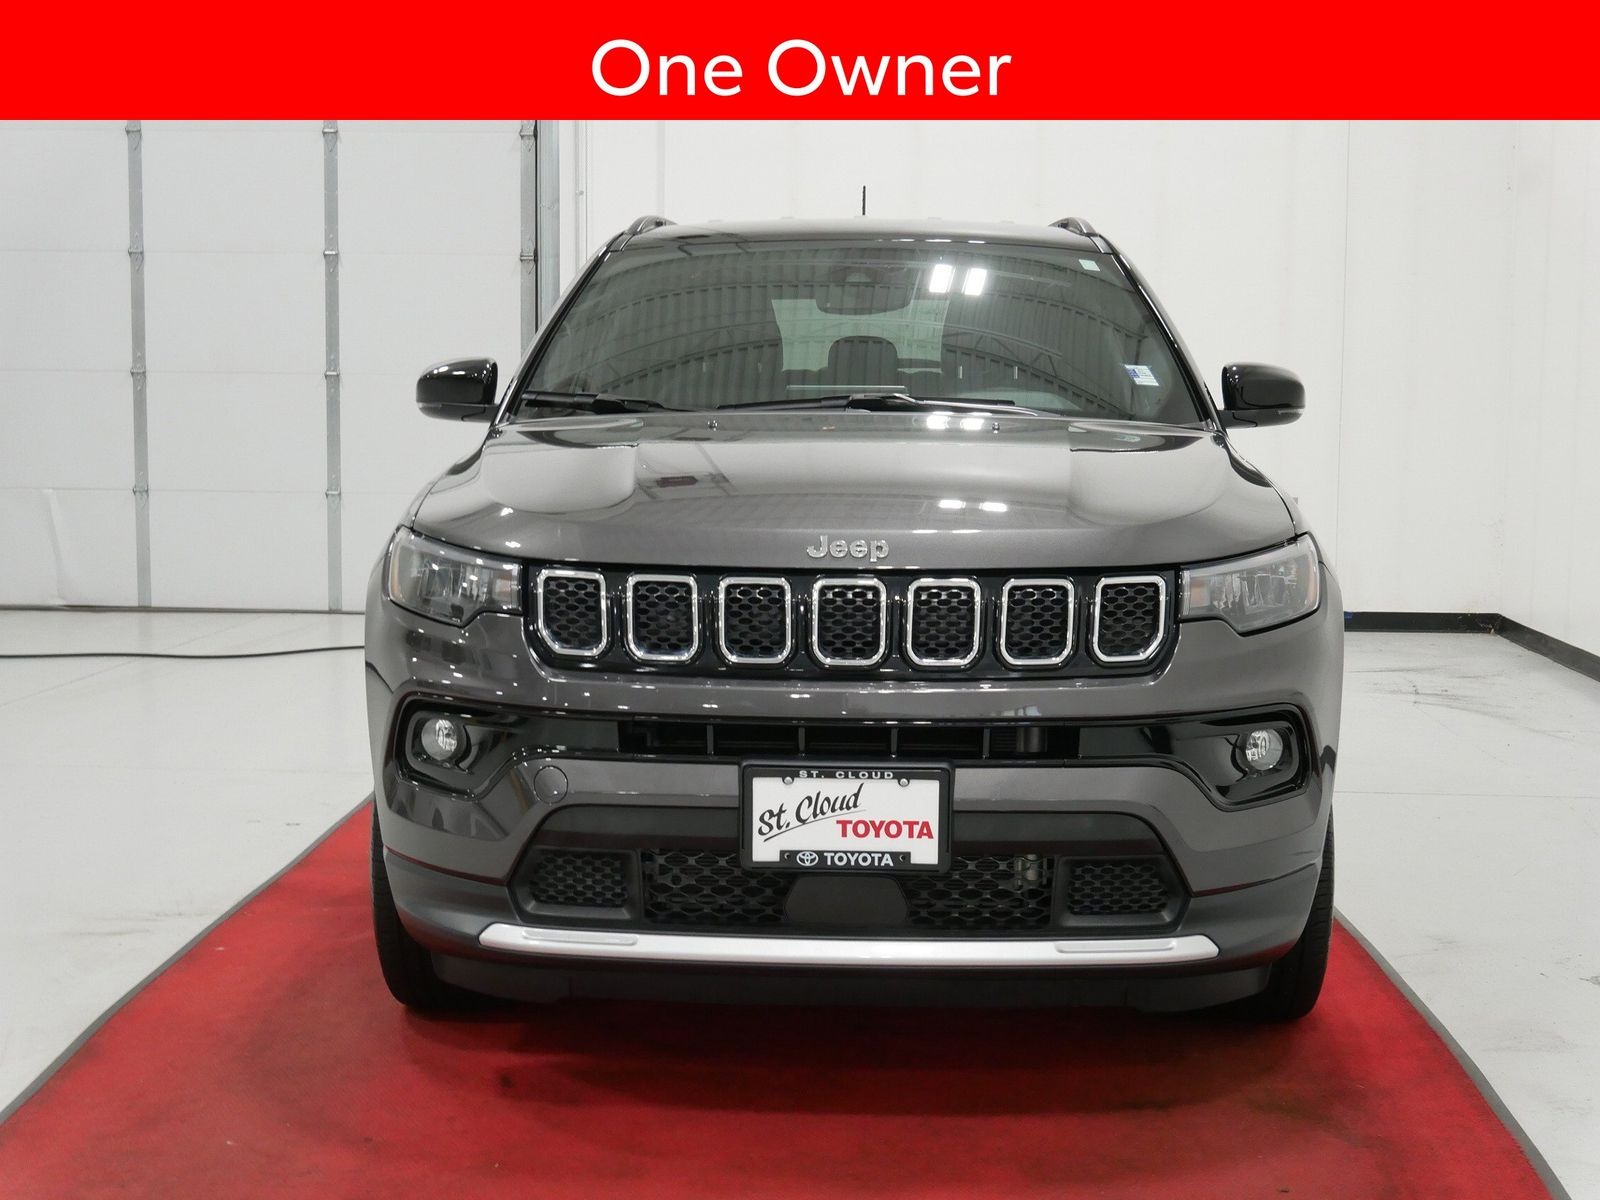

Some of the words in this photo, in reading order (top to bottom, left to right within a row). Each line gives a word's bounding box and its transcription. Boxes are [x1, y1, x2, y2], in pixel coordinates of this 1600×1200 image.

[806, 535, 889, 562] Jeep
[799, 770, 824, 779] ST.
[835, 771, 894, 780] CLOUD
[757, 803, 791, 837] St.
[795, 782, 865, 824] Cloud
[836, 820, 934, 840] TOYOTA
[823, 853, 894, 867] TOYOTA
